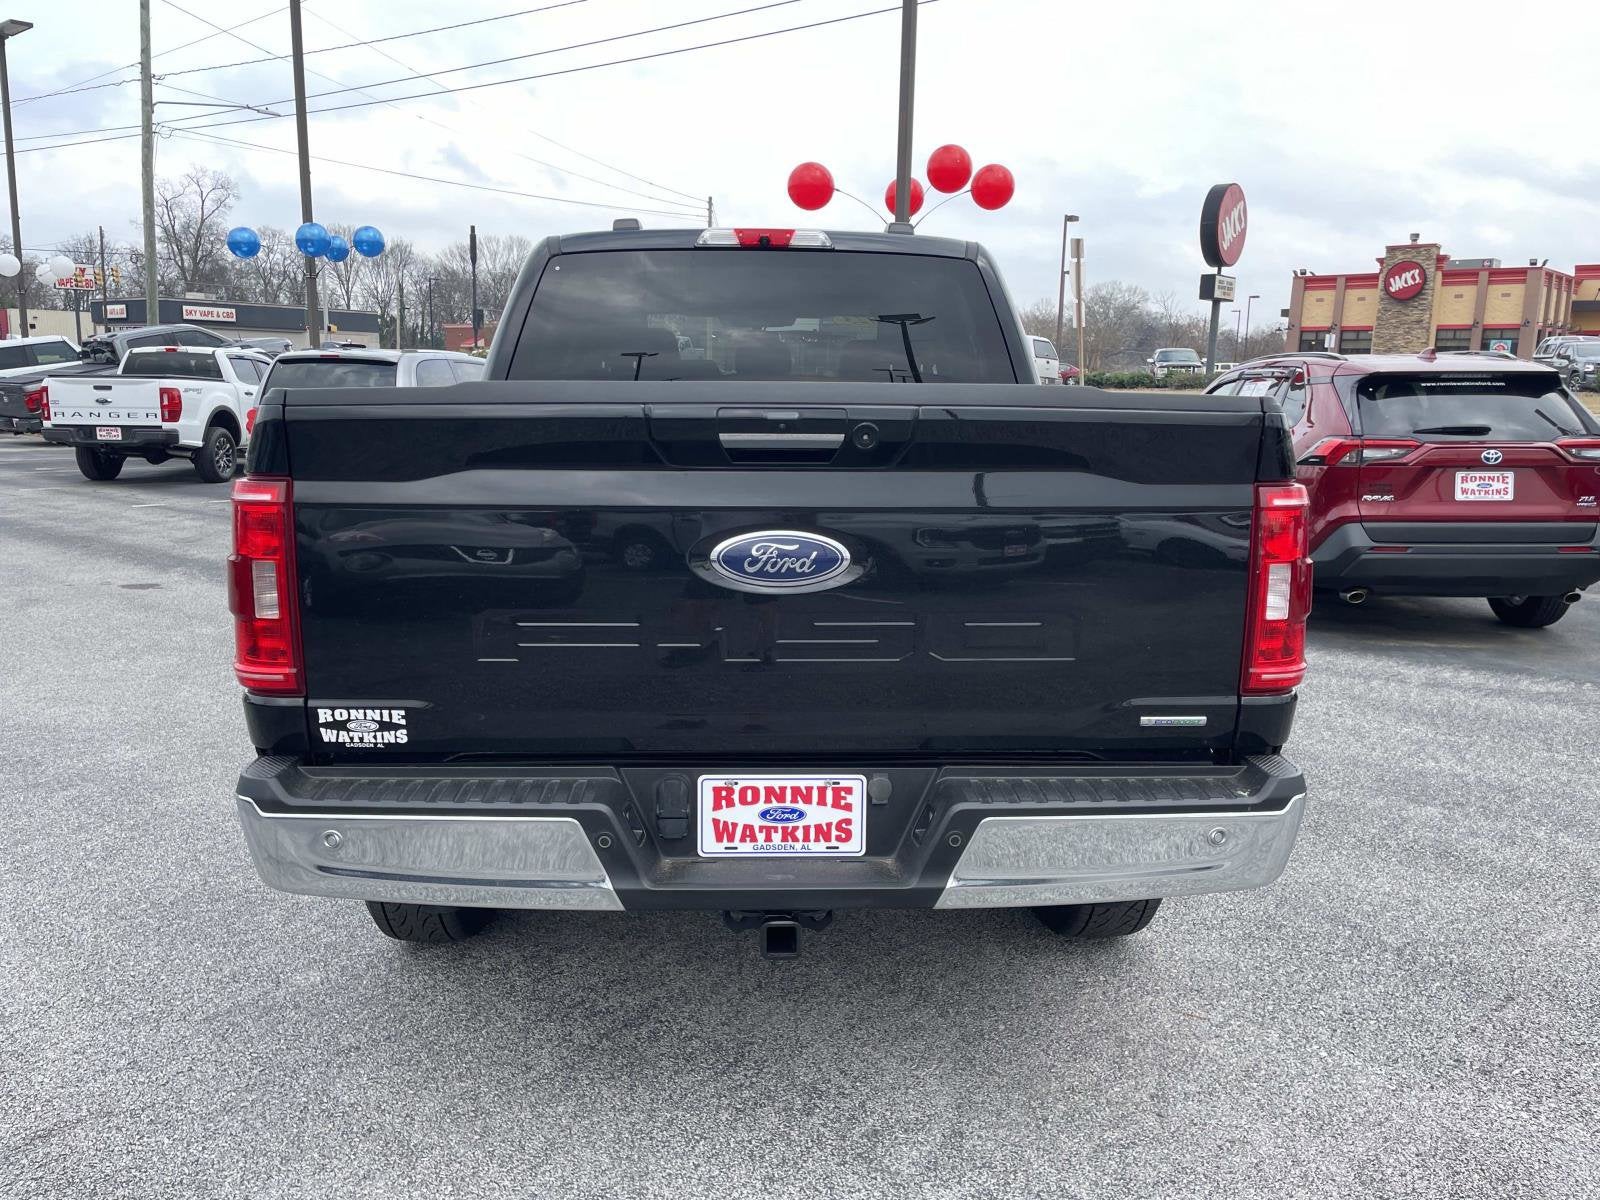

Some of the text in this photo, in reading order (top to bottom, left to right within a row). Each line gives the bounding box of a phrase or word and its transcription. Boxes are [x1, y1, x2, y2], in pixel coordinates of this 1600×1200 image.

[57, 278, 74, 288] VAPE
[184, 308, 235, 319] SKY VAPE & CBD
[53, 411, 158, 419] RANGER
[1460, 475, 1510, 485] RONNIE
[1460, 486, 1509, 496] WATKINS
[744, 542, 818, 573] Ford
[317, 708, 407, 726] RONNIE
[319, 727, 409, 744] WATKINS
[711, 785, 854, 813] RONNIE
[766, 808, 800, 821] Ford
[711, 817, 854, 844] WATKINS
[752, 843, 813, 852] GADSDEN, AL
